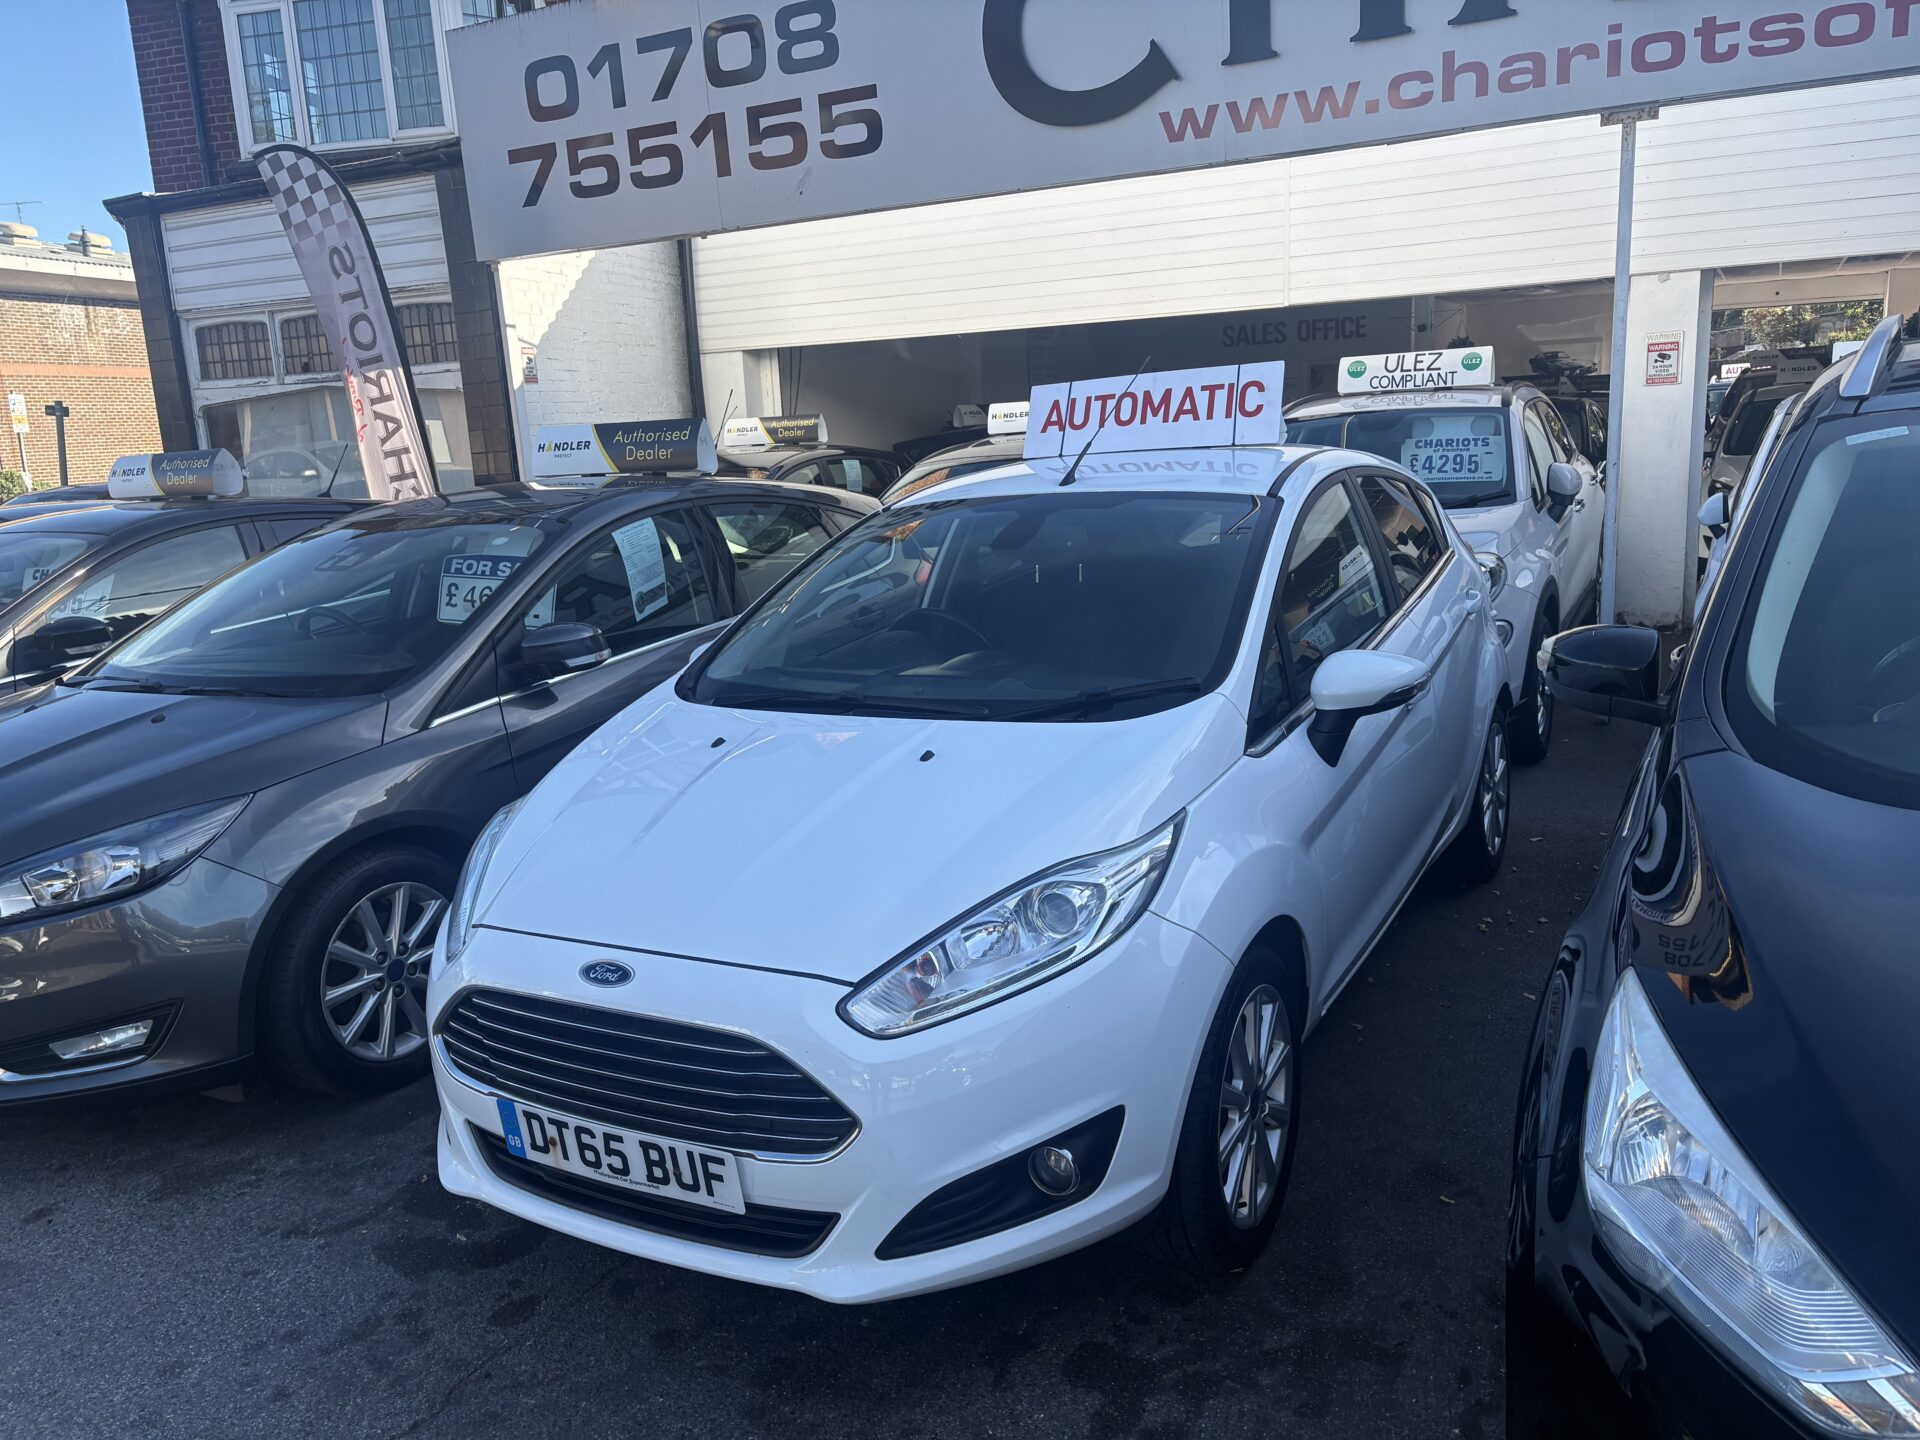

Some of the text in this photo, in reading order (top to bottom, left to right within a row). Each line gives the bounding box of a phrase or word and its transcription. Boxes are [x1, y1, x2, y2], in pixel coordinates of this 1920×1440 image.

[524, 0, 840, 123] 01708
[507, 83, 884, 208] 755155
[1222, 316, 1367, 348] SALES OFFICE
[1648, 343, 1679, 351] WARNING
[1384, 352, 1443, 373] ULEZ
[1369, 371, 1458, 390] COMPLIANT
[1040, 380, 1266, 434] AUTOMATIC
[771, 418, 815, 428] Authorised
[991, 411, 1030, 420] HANDLER
[613, 426, 691, 444] Authorised
[727, 426, 758, 434] HANDLER
[778, 429, 805, 437] Dealer
[537, 440, 591, 453] HANDLER
[1414, 437, 1490, 449] CHARIOTS
[626, 445, 673, 461] Dealer
[160, 456, 211, 470] Authorised
[1410, 453, 1479, 475] £4295
[166, 471, 198, 485] Dealer
[32, 569, 54, 581] CH
[450, 559, 521, 577] FOR S
[589, 964, 622, 982] Ford
[508, 1134, 521, 1148] GB
[522, 1109, 726, 1198] DT65 BUF
